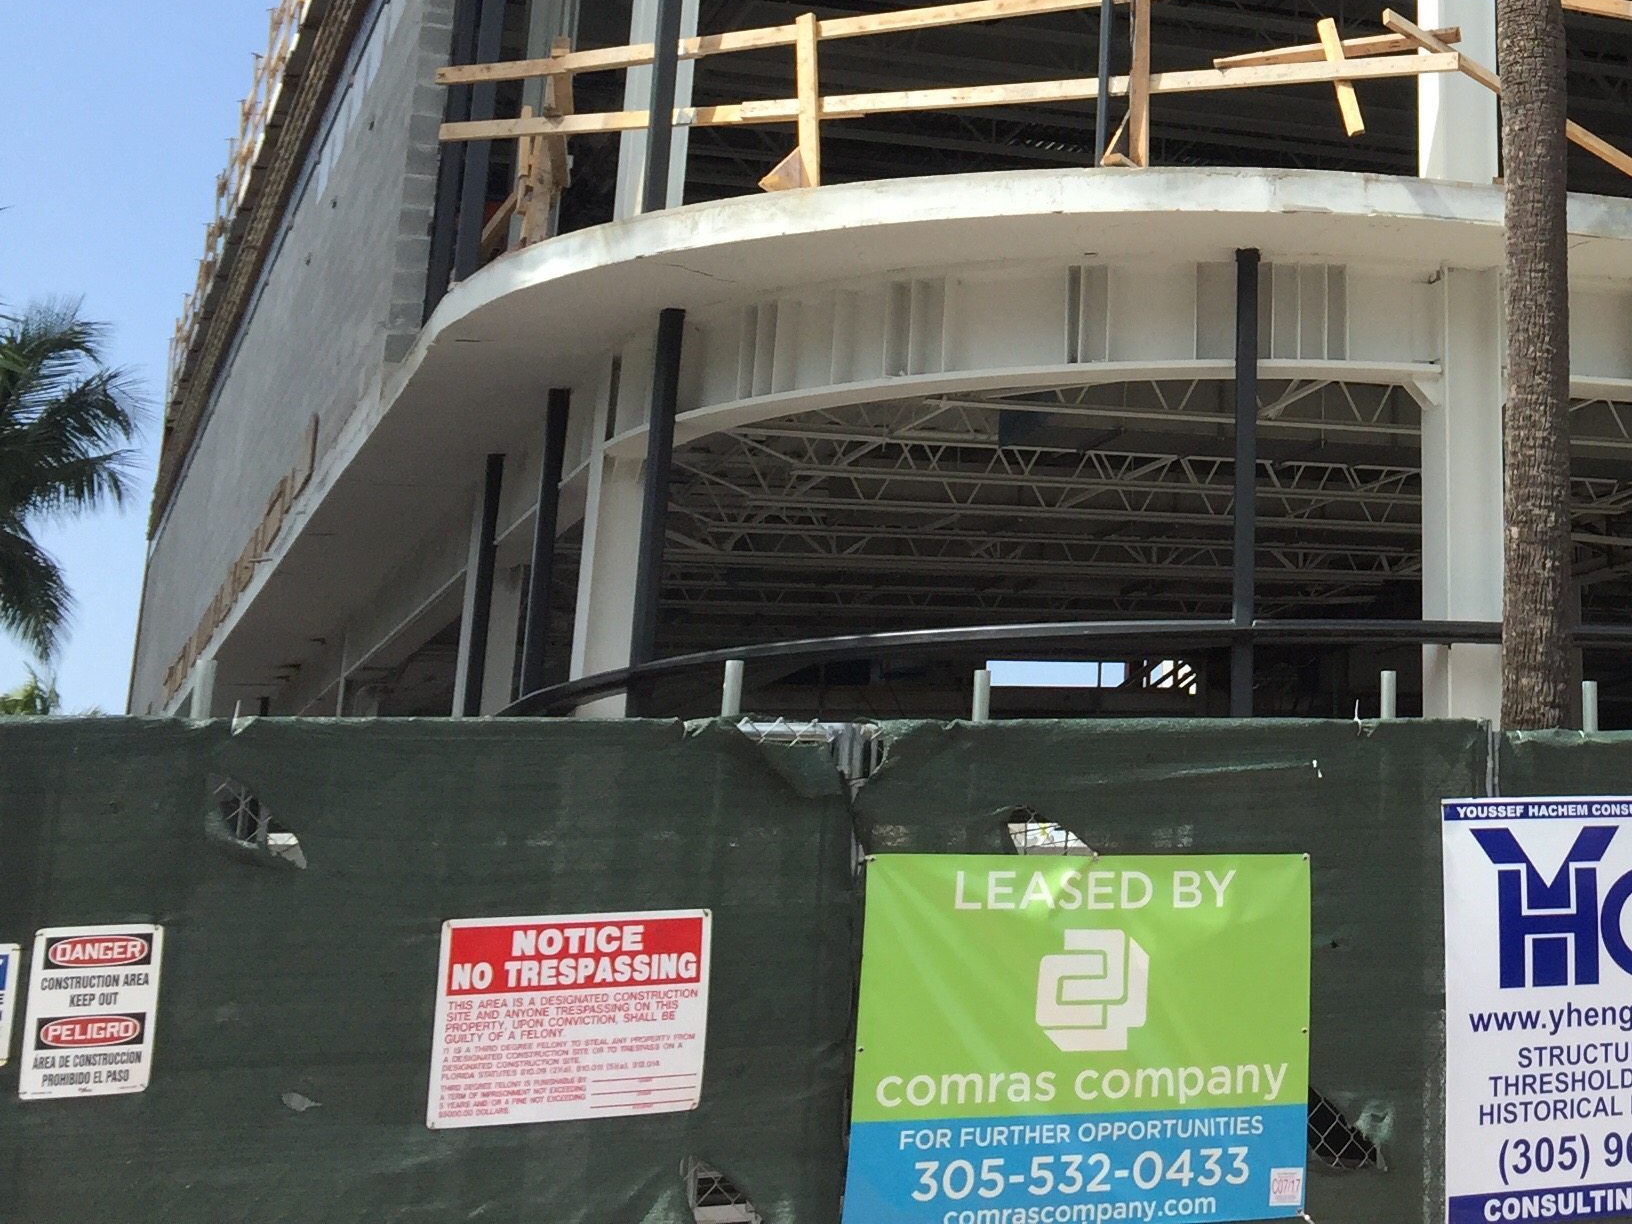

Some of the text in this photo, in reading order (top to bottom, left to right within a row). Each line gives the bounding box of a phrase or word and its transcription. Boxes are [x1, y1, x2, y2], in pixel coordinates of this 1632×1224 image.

[1456, 805, 1524, 819] YOUSSEF
[1529, 804, 1588, 817] HACHEM
[954, 869, 1237, 910] LEASED BY
[55, 941, 142, 961] DANGER
[512, 925, 645, 957] NOTICE
[40, 973, 149, 991] CONSTRUCTION AREA
[450, 952, 697, 990] NO TRESPASSING
[69, 992, 119, 1007] KEEP OUT
[448, 989, 698, 1011] THIS AREA IS A DESIGNATED CONSTRUCTION
[446, 1000, 679, 1022] SITE AND ANYONE TRESPASSING ON THIS
[512, 1018, 544, 1029] UPON
[623, 1012, 657, 1023] SHALL
[661, 1011, 676, 1020] BE
[47, 1021, 134, 1041] PELIGRO
[444, 1033, 483, 1044] GUILTY
[488, 1032, 503, 1042] OF
[508, 1031, 515, 1040] A
[58, 1055, 71, 1068] DE
[41, 1069, 130, 1087] PROHIBIDO EL PASO
[876, 1062, 1289, 1107] comras company
[1479, 1096, 1623, 1126] HISTORICAL
[899, 1116, 1264, 1151] FOR FURTHER OPPORTUNITIES
[1499, 1133, 1591, 1186] (305)
[911, 1146, 1250, 1202] 305-532-0433
[943, 1196, 1217, 1224] comrascompany.com
